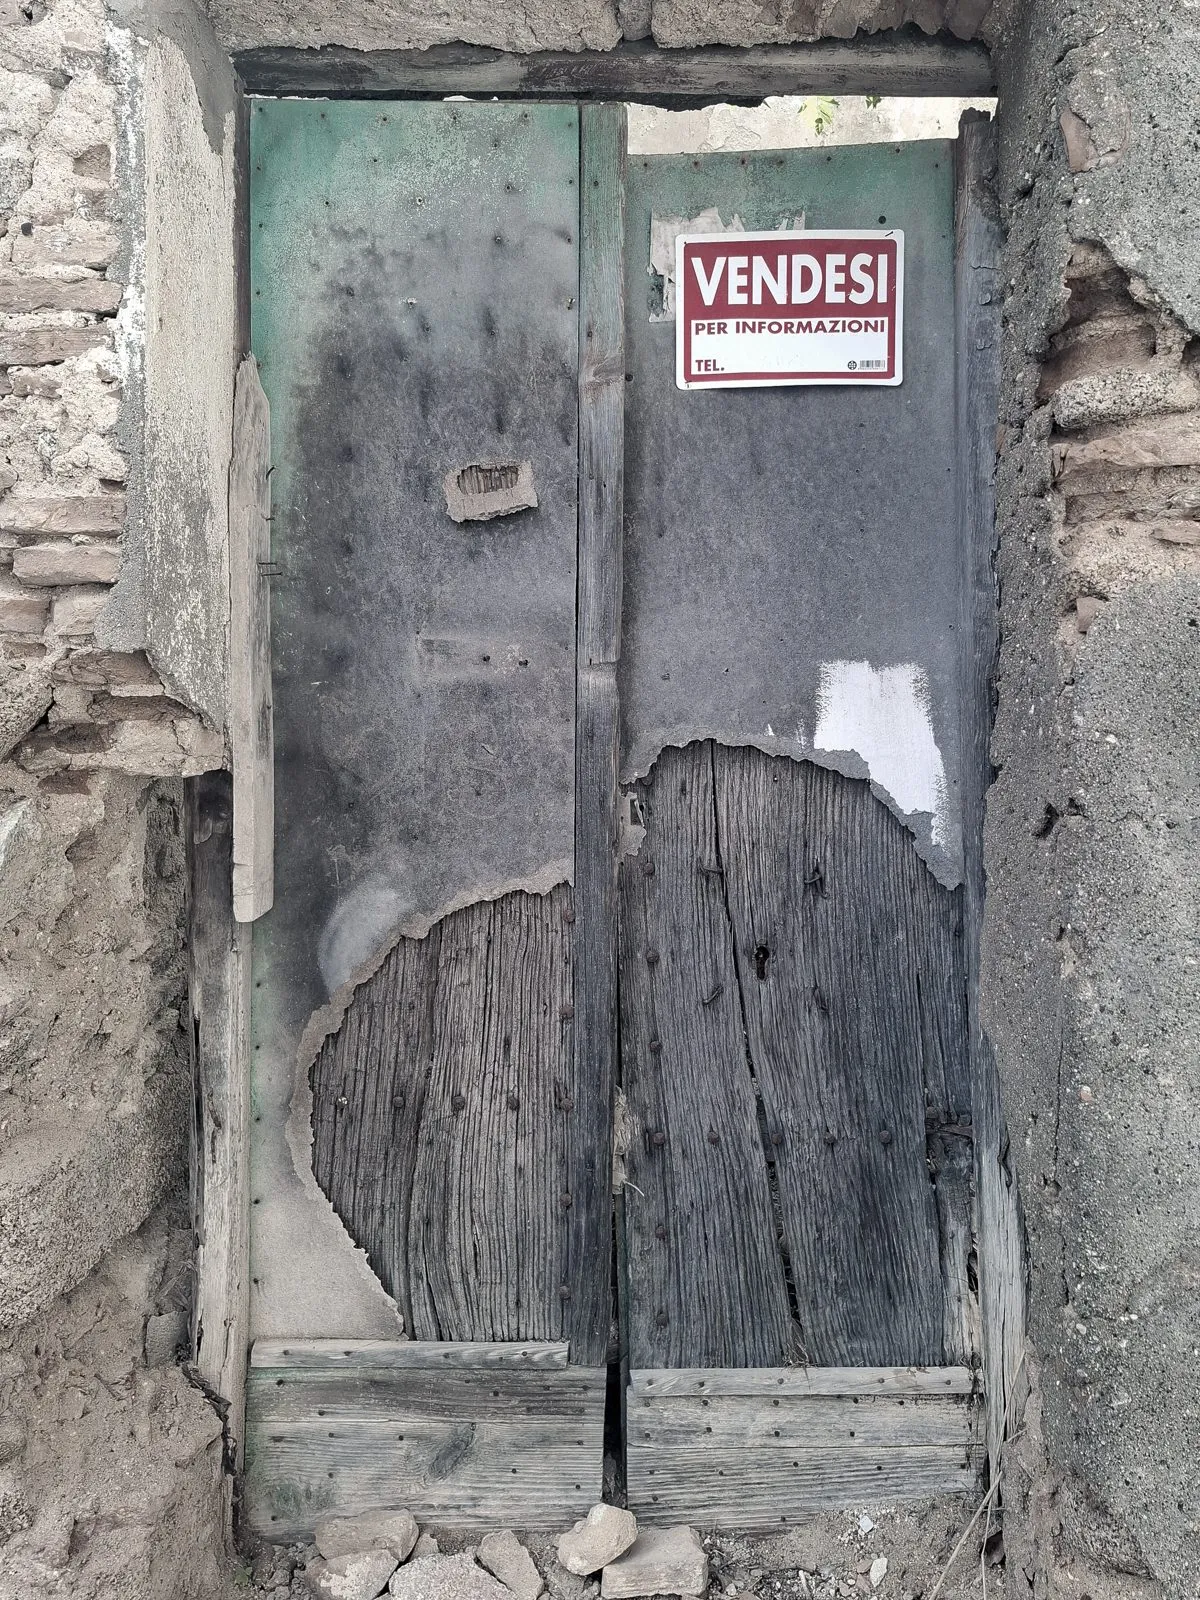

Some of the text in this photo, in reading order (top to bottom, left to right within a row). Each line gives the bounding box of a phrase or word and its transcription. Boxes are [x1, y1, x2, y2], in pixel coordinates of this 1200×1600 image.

[691, 253, 888, 306] VENDESI
[695, 320, 885, 335] PER INFORMAZIONI
[695, 359, 725, 372] TEL.
